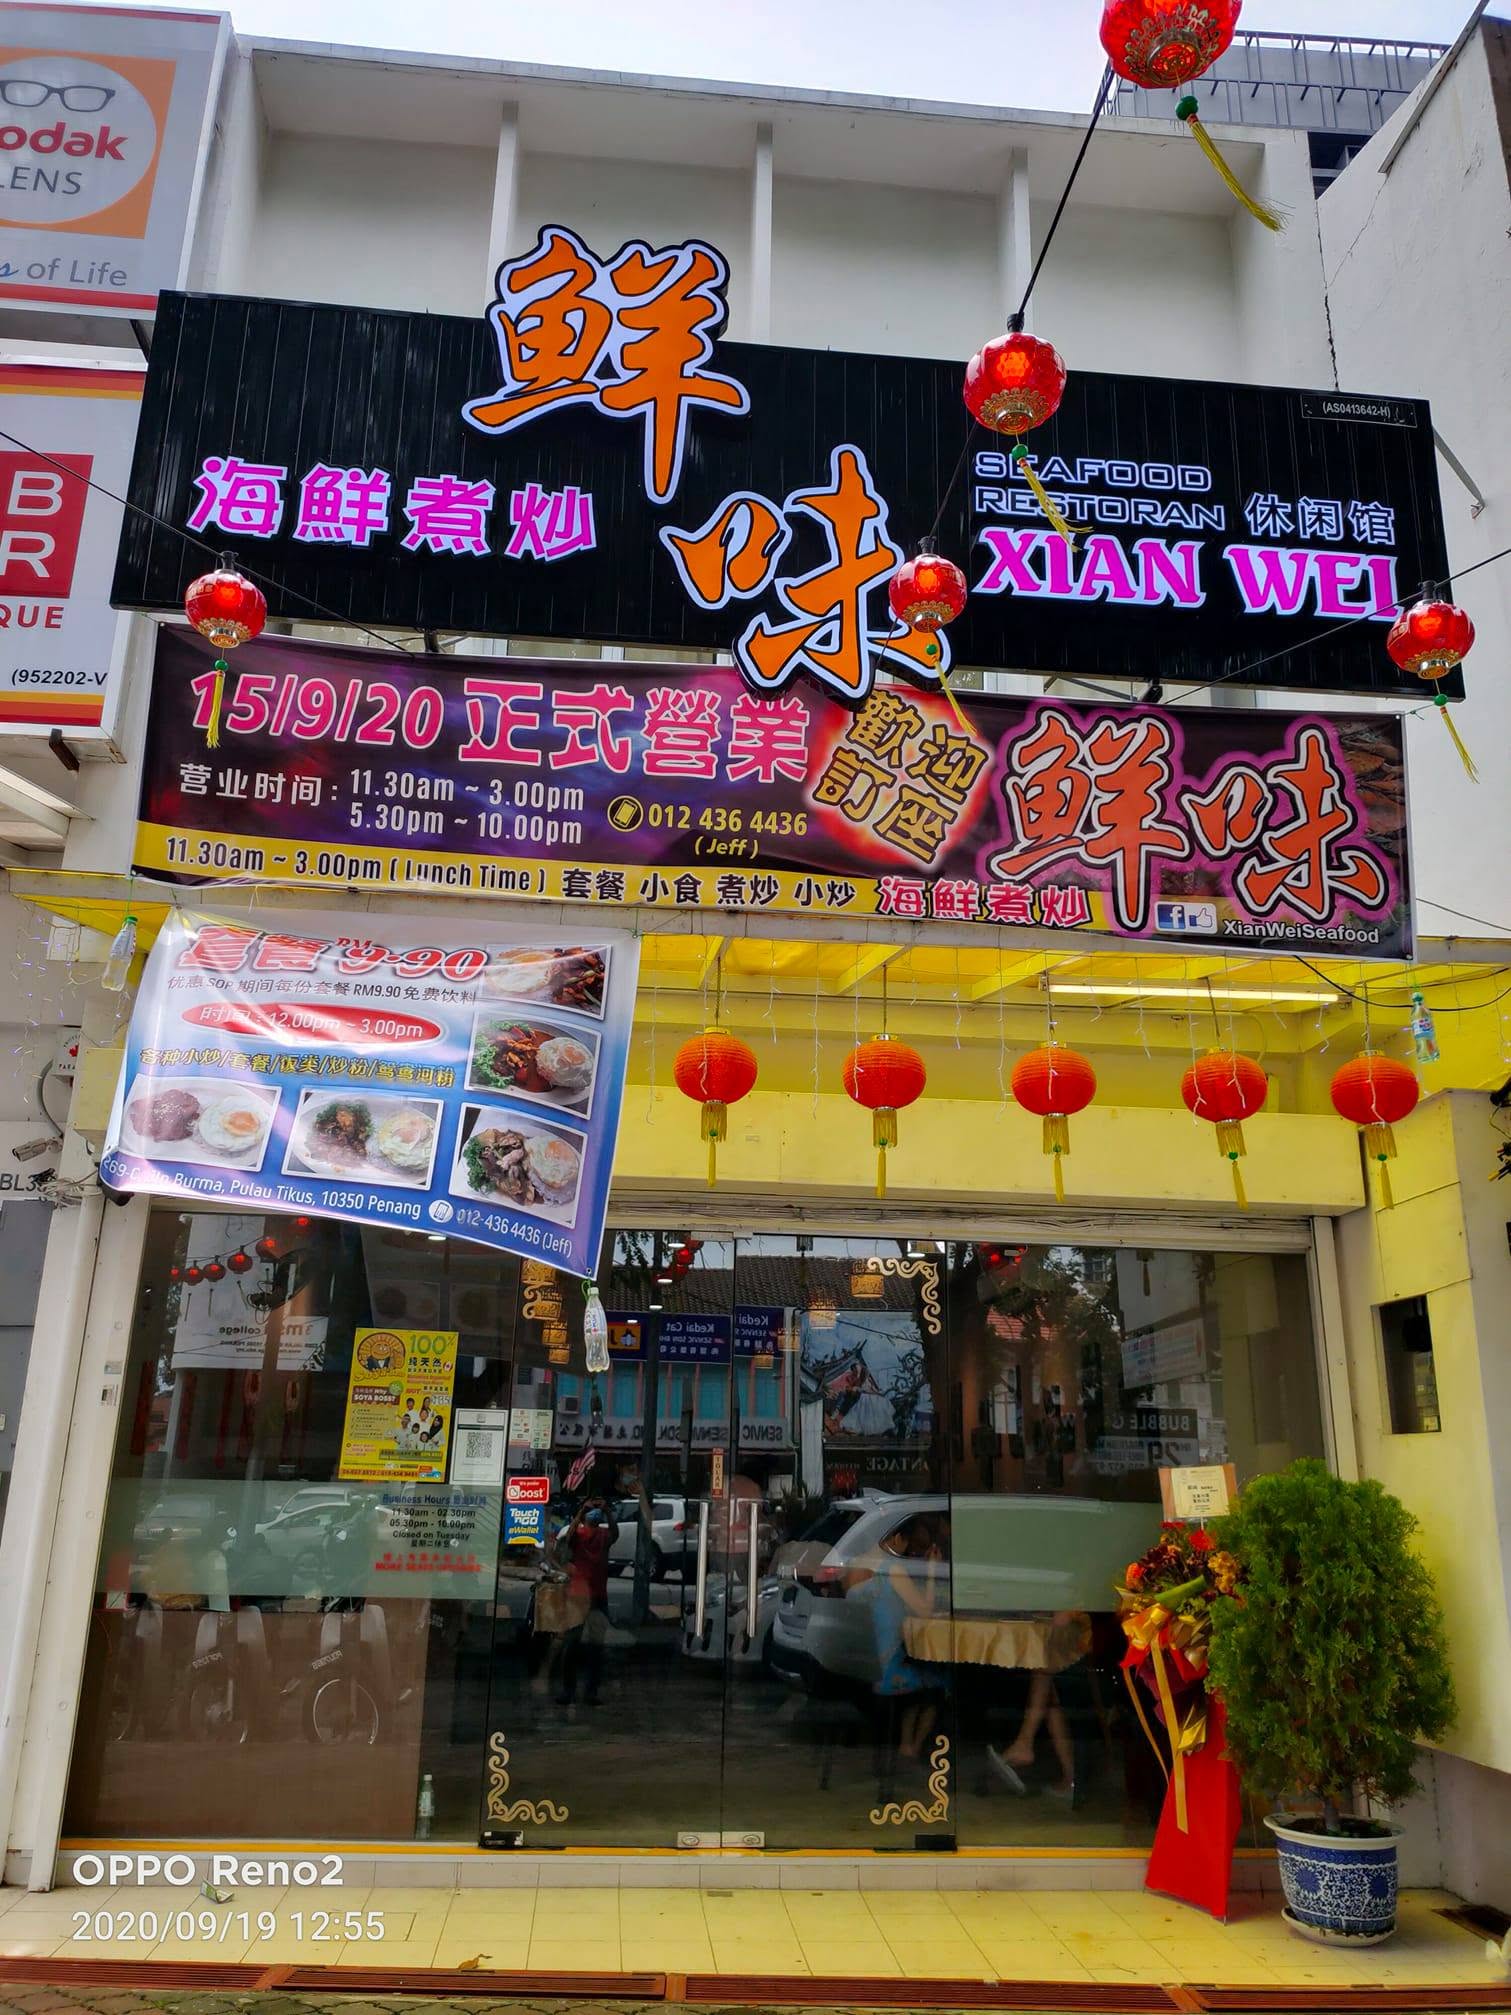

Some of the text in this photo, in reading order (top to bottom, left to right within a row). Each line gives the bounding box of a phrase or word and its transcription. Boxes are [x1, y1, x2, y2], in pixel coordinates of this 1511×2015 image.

[27, 258, 60, 281] of
[69, 260, 128, 287] Life
[1322, 401, 1391, 418] (AS0413642-H)
[975, 451, 1212, 492] SEAFOOD
[7, 471, 64, 516] B
[186, 456, 598, 564] 海鮮煮炒
[975, 486, 1225, 531] RESTORAN
[1244, 492, 1396, 546] 休闲馆
[0, 530, 56, 578] R
[971, 526, 1405, 622] XIAN WEI
[11, 668, 107, 686] (952202-V
[190, 669, 811, 784] 15/9/20 正式營業
[350, 769, 455, 801] 11.30am
[489, 778, 585, 811] 3.00pm
[812, 746, 958, 865] 訂座
[350, 802, 444, 835] 5.30pm
[477, 812, 583, 845] 10.00pm
[648, 803, 808, 836] 012 436 4436
[166, 836, 265, 871] 11.30am
[295, 851, 382, 882] 3.00pm
[561, 868, 625, 903] 套餐
[639, 872, 703, 905] 小食
[717, 875, 779, 907] 煮炒
[793, 879, 857, 909] 小炒
[878, 876, 1092, 928] 海鮮煮炒
[1223, 920, 1380, 944] XianWeiSeafood
[337, 944, 489, 982] 9.90
[353, 982, 401, 998] RM9.90
[403, 983, 477, 1005] 免费饮料
[268, 1011, 341, 1033] 12.00pm
[359, 1018, 423, 1039] 3.00pm
[175, 1172, 225, 1194] Burma,
[230, 1179, 272, 1199] Pulau
[276, 1185, 316, 1206] Tikus,
[321, 1190, 364, 1209] 10350
[367, 1194, 421, 1220] Penang
[456, 1207, 509, 1234] 012-436
[510, 1221, 541, 1245] 4436
[541, 1231, 573, 1258] (Jeff)
[383, 1493, 422, 1504] Business
[424, 1493, 451, 1504] Hours
[510, 1508, 540, 1517] Touch
[392, 1530, 422, 1539] Closed
[436, 1531, 470, 1541] Tuesday
